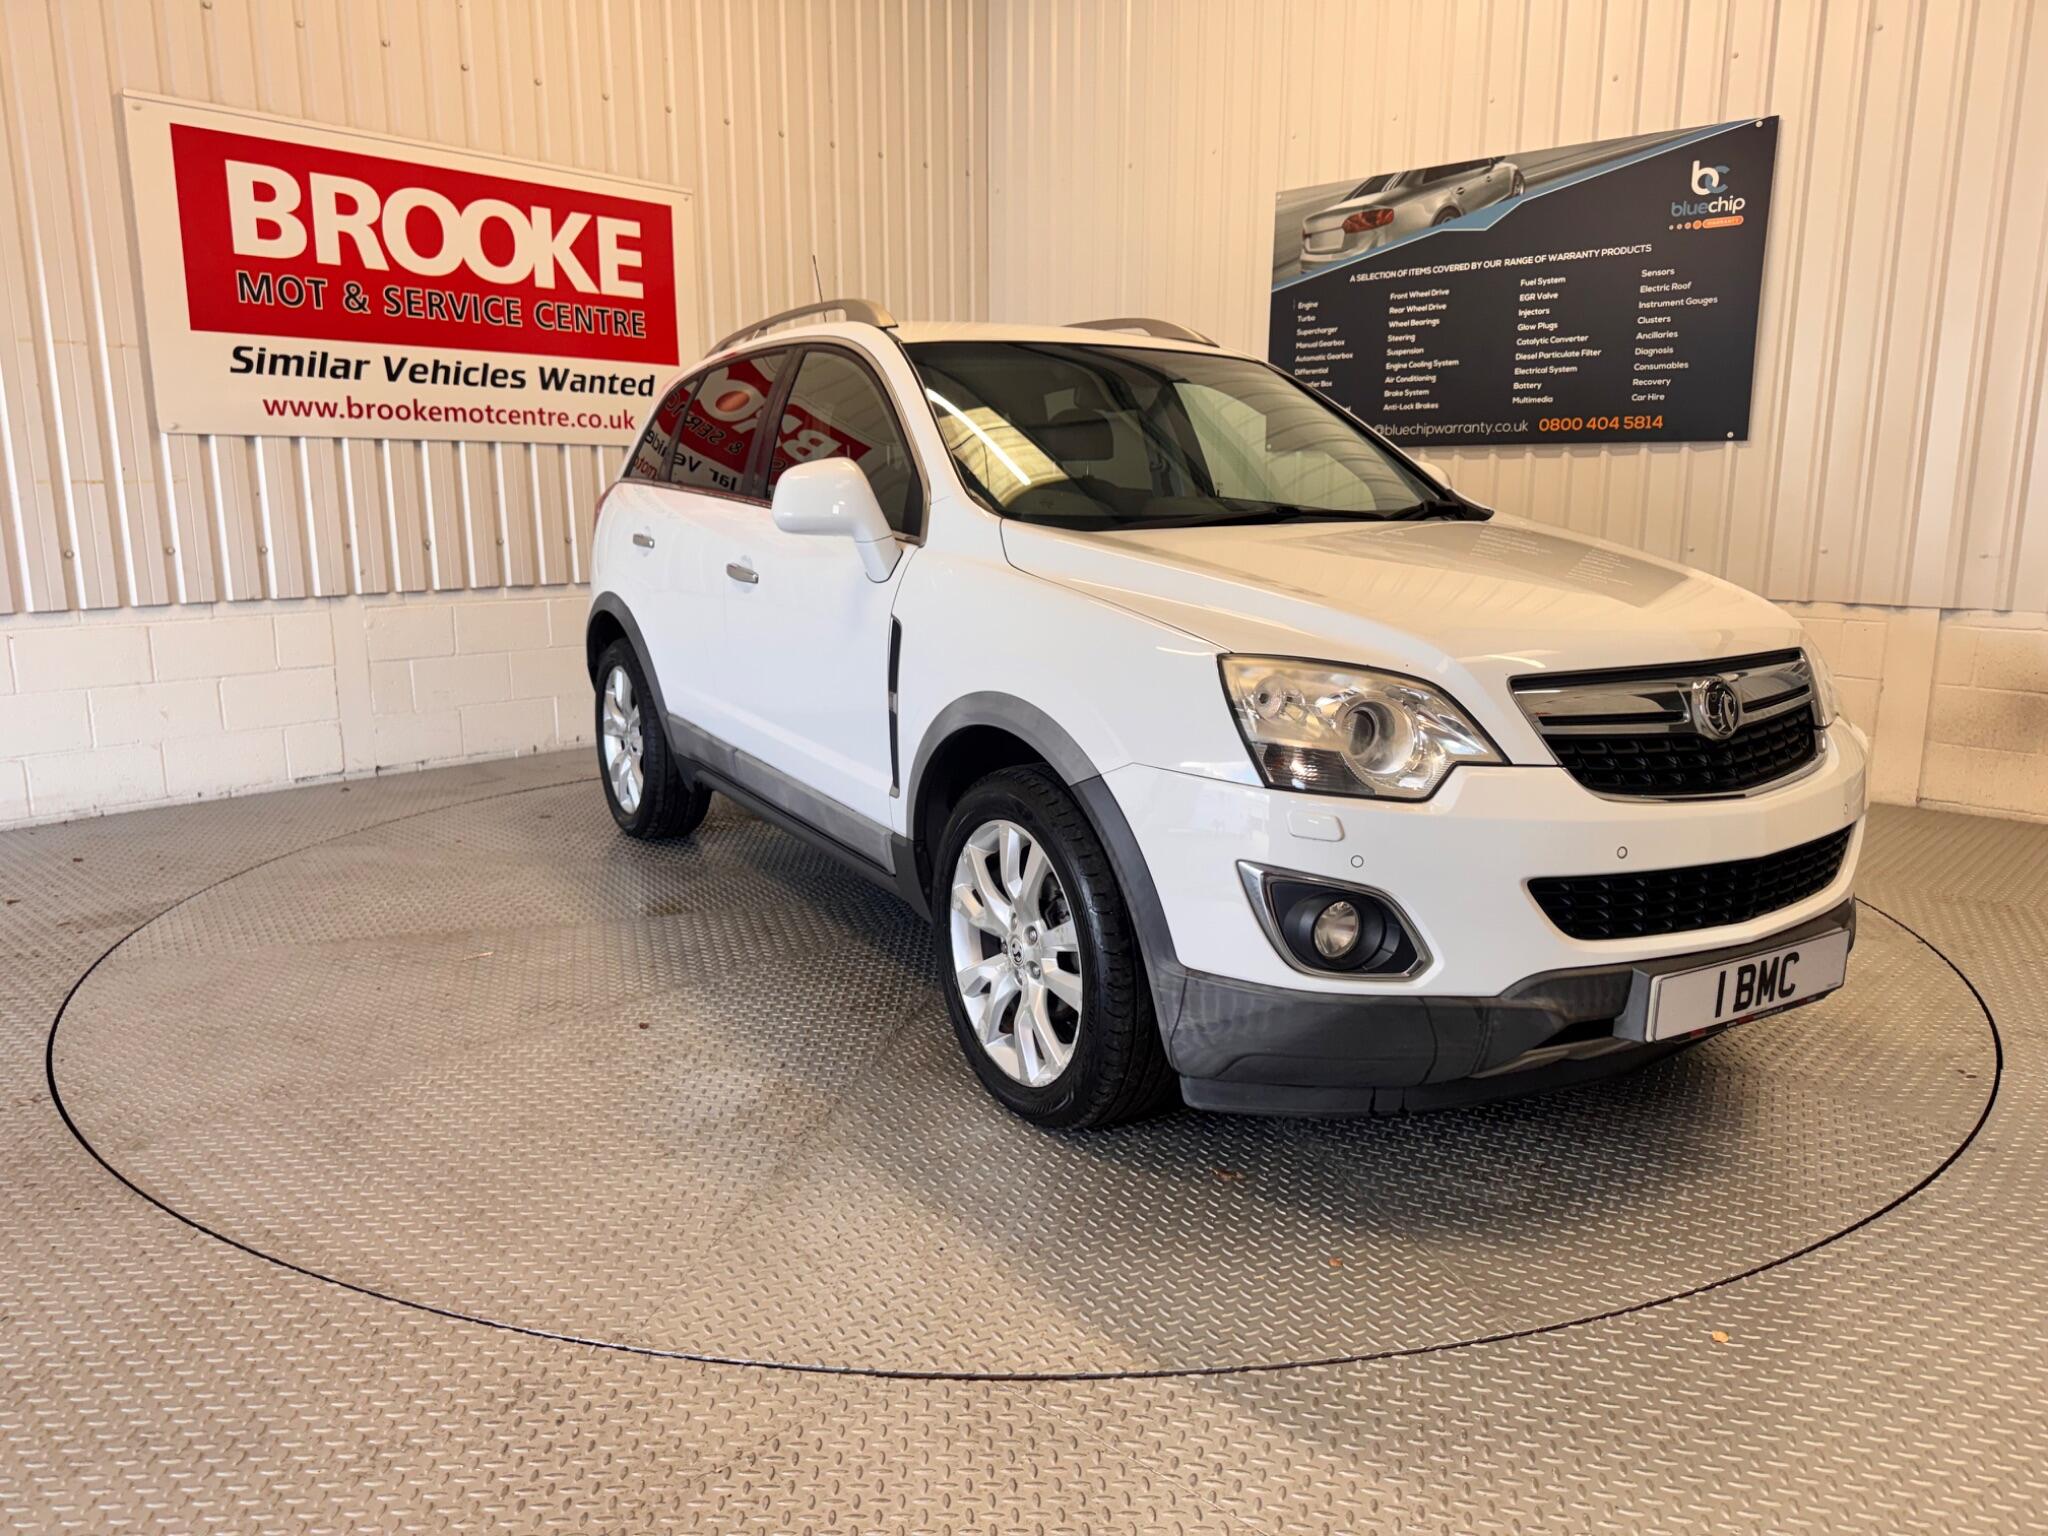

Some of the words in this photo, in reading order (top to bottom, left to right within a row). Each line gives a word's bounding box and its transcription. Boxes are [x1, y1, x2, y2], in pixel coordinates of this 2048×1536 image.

[1671, 195, 1746, 217] bluechip
[225, 159, 645, 299] BROOKE
[1349, 275, 1356, 283] A
[1356, 270, 1398, 282] SELECTION
[1398, 269, 1408, 278] OF
[1408, 267, 1432, 276] ITEMS
[1432, 262, 1471, 274] COVERED
[1471, 261, 1483, 270] BY
[1483, 259, 1502, 268] OUR
[1504, 256, 1534, 267] RANGE
[1534, 254, 1548, 264] OF
[1548, 249, 1601, 262] WARRANTY
[1601, 243, 1652, 257] PRODUCTS
[1641, 267, 1675, 278] Sensors
[1520, 278, 1537, 287] Fuel
[1537, 276, 1566, 287] System
[1640, 283, 1670, 293] Electric
[1671, 281, 1692, 291] Roof
[1408, 291, 1431, 299] Wheel
[1431, 289, 1450, 297] Drive
[1519, 293, 1536, 302] EGR
[1536, 291, 1559, 300] Valve
[236, 269, 328, 310] MOT
[343, 281, 371, 315] &
[383, 284, 523, 327] SERVICE
[533, 299, 646, 339] CENTRE
[1297, 301, 1319, 311] Engine
[1638, 299, 1685, 309] Instrument
[1685, 296, 1718, 307] Gauges
[1406, 305, 1428, 313] Wheel
[1428, 303, 1447, 311] Drive
[1518, 307, 1550, 318] Injectors
[1388, 320, 1410, 328] Wheel
[1410, 318, 1440, 327] Bearings
[1637, 315, 1672, 325] Clusters
[1517, 323, 1537, 331] Glow
[1537, 321, 1558, 331] Plugs
[1296, 327, 1338, 337] Supercharger
[1635, 330, 1679, 340] Ancillaries
[1318, 339, 1345, 347] Gearbox
[1387, 333, 1416, 343] Steering
[1516, 337, 1549, 347] Catalytic
[1550, 335, 1589, 344] Converter
[1386, 347, 1424, 357] Suspension
[1515, 352, 1538, 361] Diesel
[1538, 350, 1580, 360] Particulate
[1581, 348, 1602, 357] Filter
[1635, 346, 1674, 357] Diagnosis
[1295, 355, 1326, 363] Automatic
[1326, 352, 1354, 360] Gearbox
[1385, 363, 1408, 372] Engine
[1408, 360, 1433, 370] Cooling
[1433, 359, 1460, 368] System
[1514, 366, 1548, 375] Electrical
[1549, 365, 1578, 375] System
[1633, 361, 1689, 372] Consumables
[229, 345, 371, 381] Similar
[383, 355, 527, 389] Vehicles
[538, 366, 655, 397] Wanted
[1294, 367, 1329, 376] Differential
[1320, 380, 1333, 388] Box
[1395, 374, 1437, 384] Conditioning
[1632, 378, 1672, 387] Recovery
[1513, 381, 1542, 391] Battery
[1404, 388, 1430, 398] System
[1631, 393, 1646, 402] Car
[1647, 393, 1665, 401] Hire
[1512, 395, 1554, 404] Multimedia
[1383, 403, 1414, 411] Anti-Lock
[1415, 402, 1439, 410] Brakes
[262, 395, 636, 430] www.brookemotcentre.co.uk
[1538, 417, 1583, 432] 0800
[1585, 416, 1620, 430] 404
[1623, 415, 1664, 430] 5814
[1733, 952, 1800, 1013] BMC
